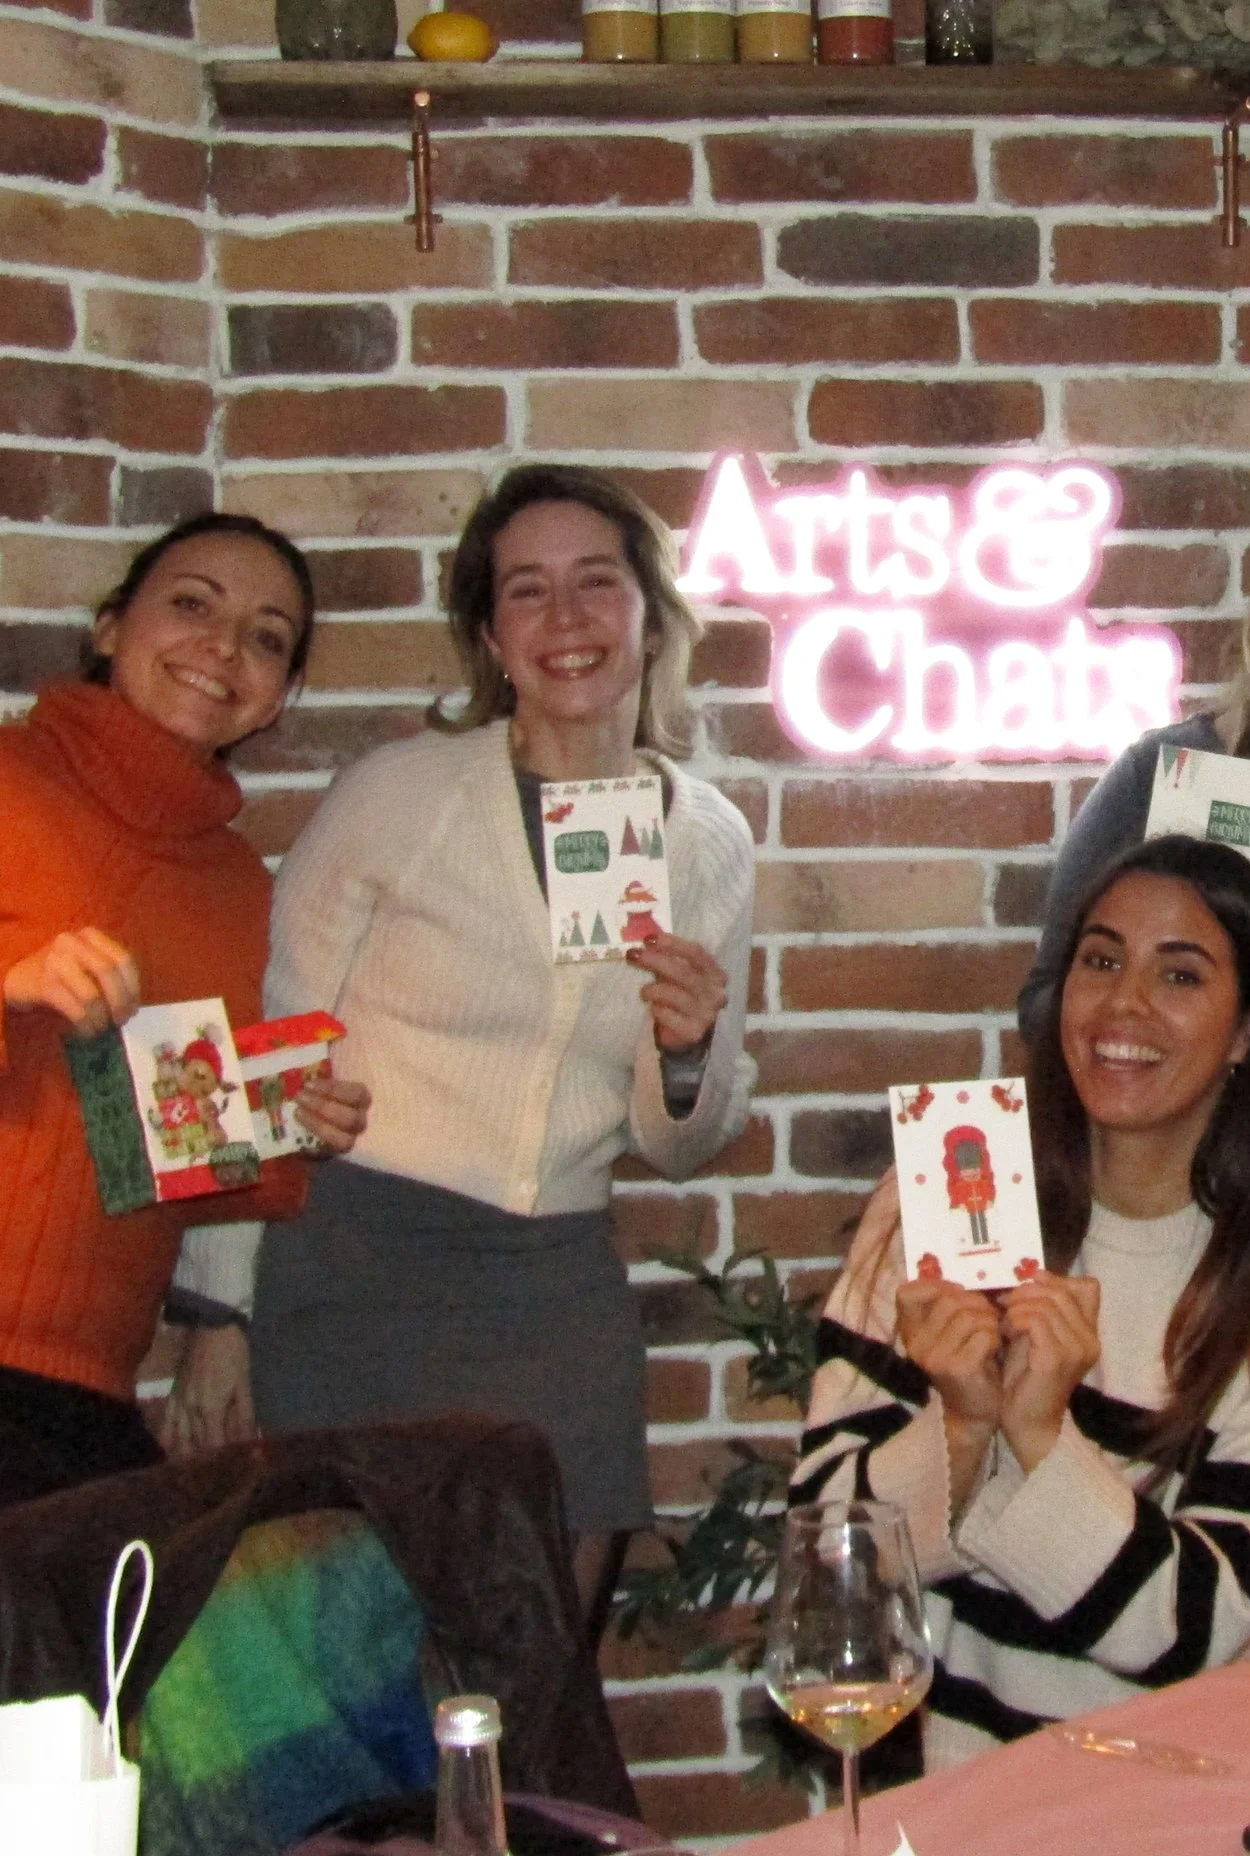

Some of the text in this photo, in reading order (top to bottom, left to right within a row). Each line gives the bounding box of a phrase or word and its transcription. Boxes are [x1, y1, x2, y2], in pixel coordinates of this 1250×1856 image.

[674, 453, 1113, 608] Arts &
[779, 608, 1175, 754] Chats
